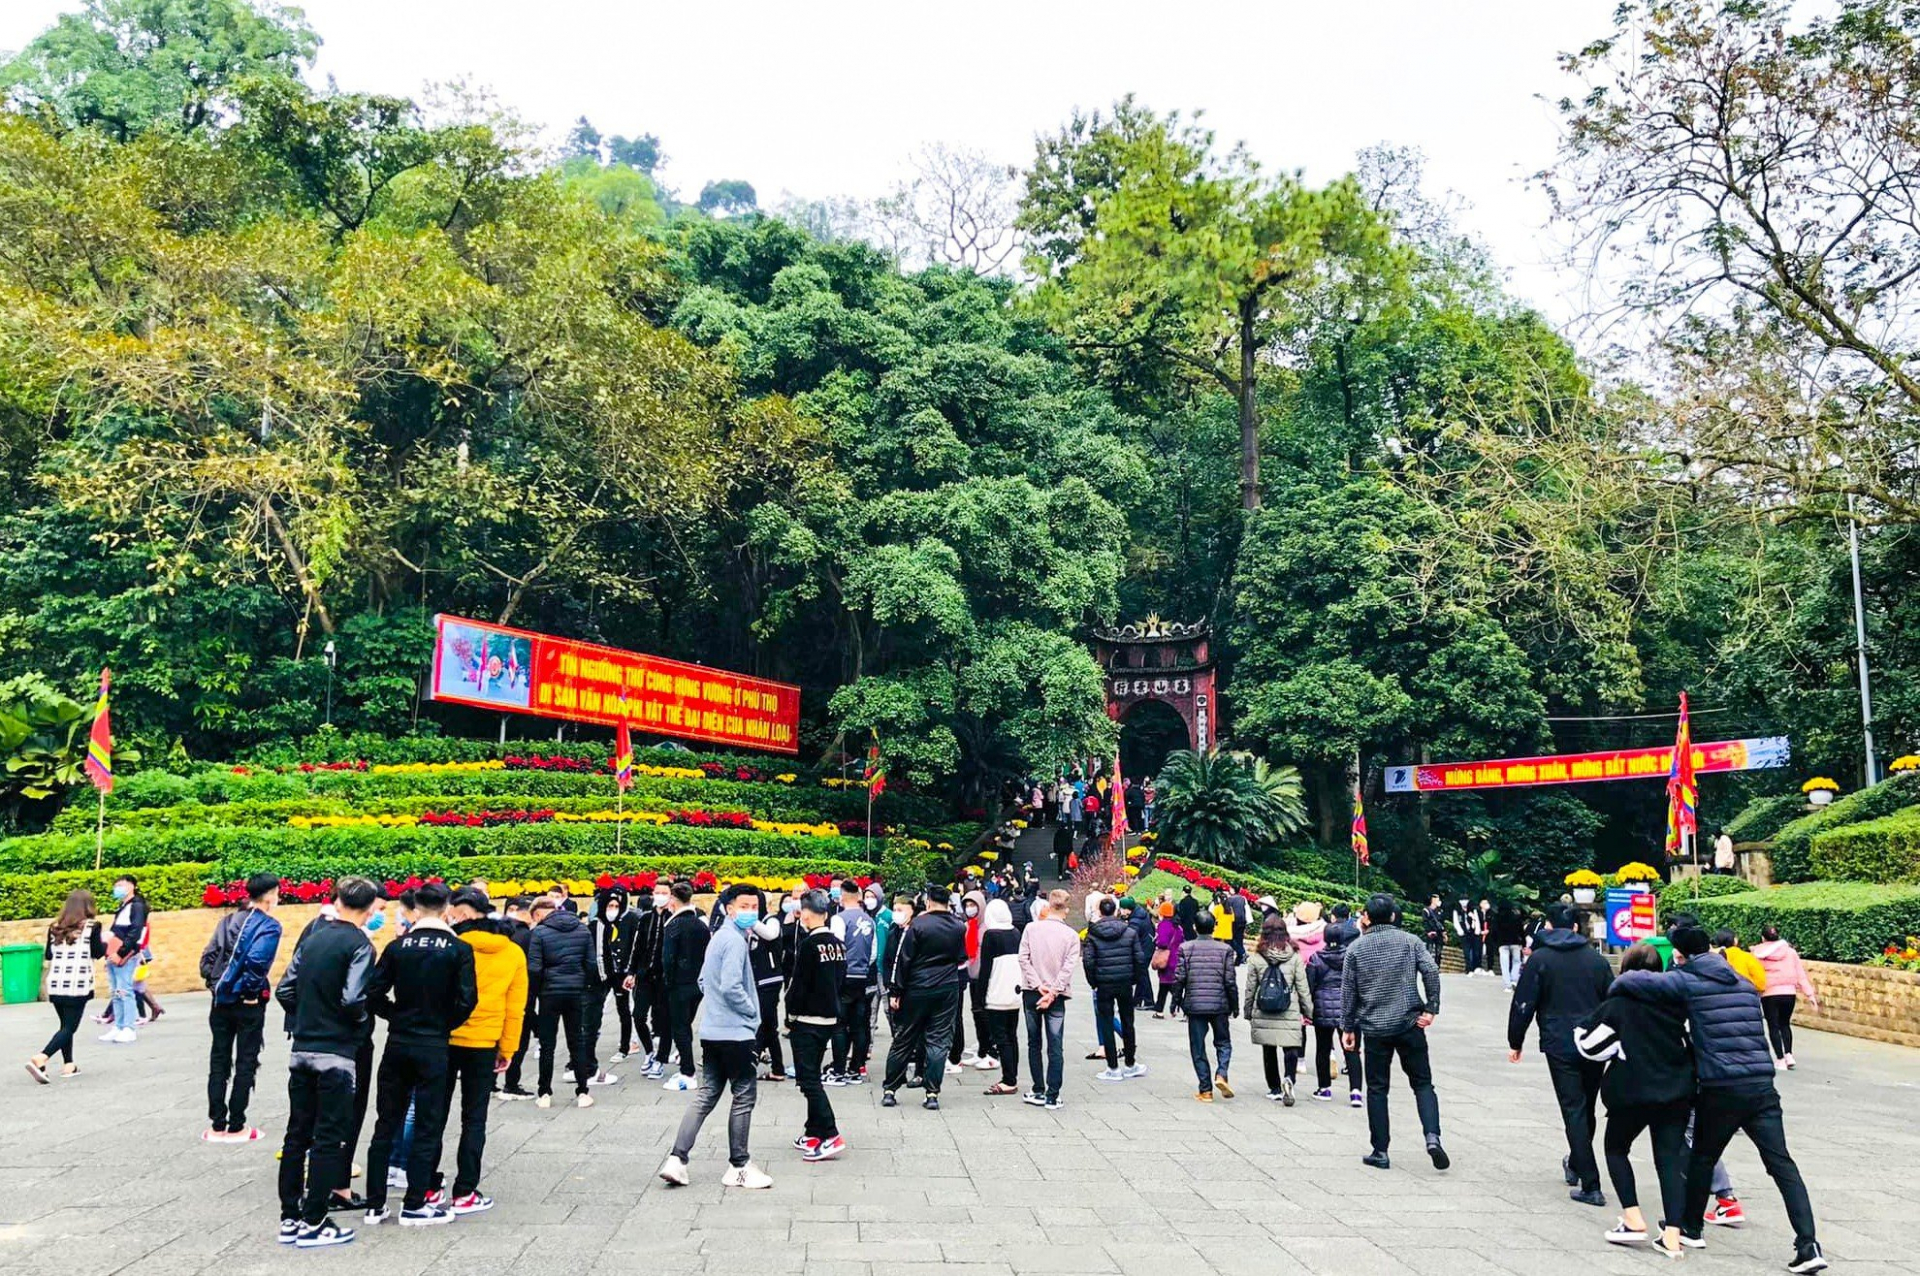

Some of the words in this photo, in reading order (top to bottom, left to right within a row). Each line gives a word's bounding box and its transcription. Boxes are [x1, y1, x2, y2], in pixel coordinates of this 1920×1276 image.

[539, 682, 552, 704] DI
[627, 698, 643, 718] PHI
[742, 688, 761, 710] PHÚ
[762, 692, 779, 717] THỌ
